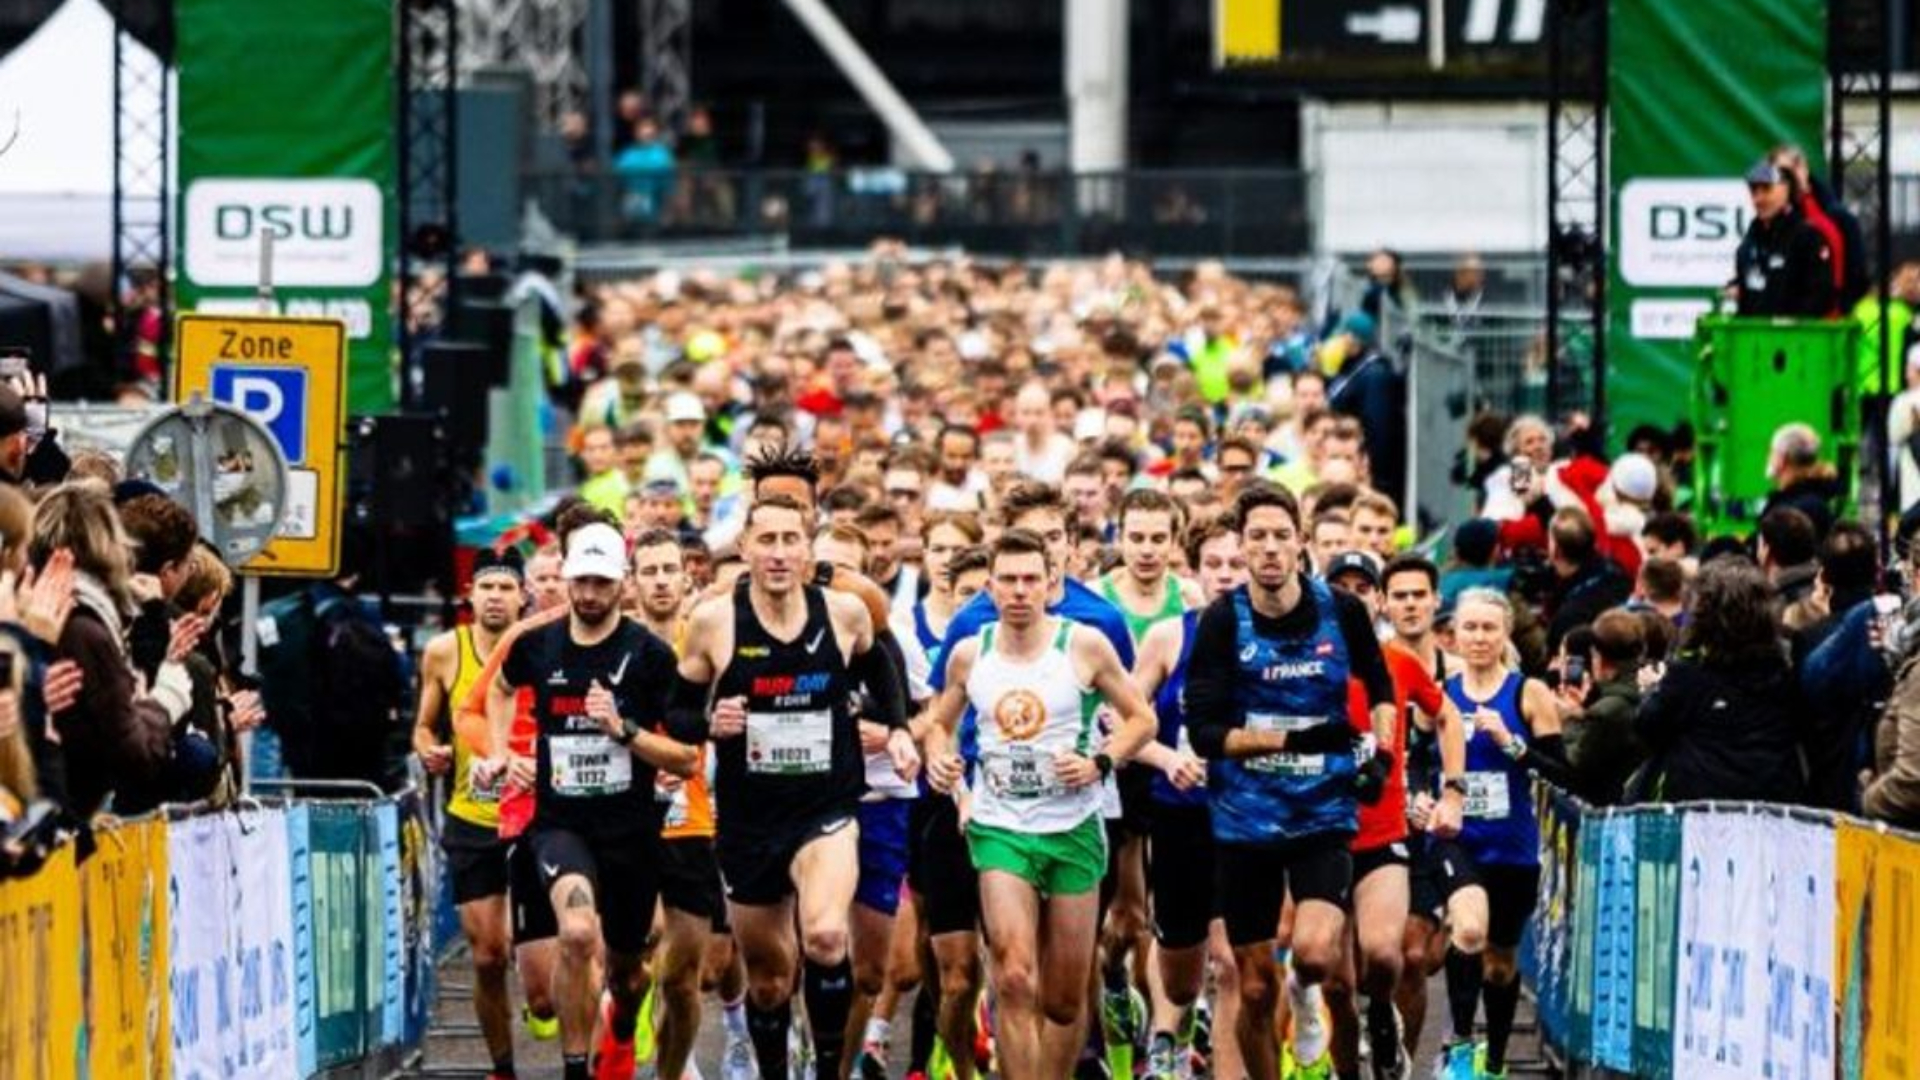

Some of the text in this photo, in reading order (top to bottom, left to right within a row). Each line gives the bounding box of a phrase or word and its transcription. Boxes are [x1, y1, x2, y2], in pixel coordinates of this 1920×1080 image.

[215, 204, 353, 240] DSW
[218, 329, 294, 360] Zone
[1270, 660, 1325, 680] FRANCE
